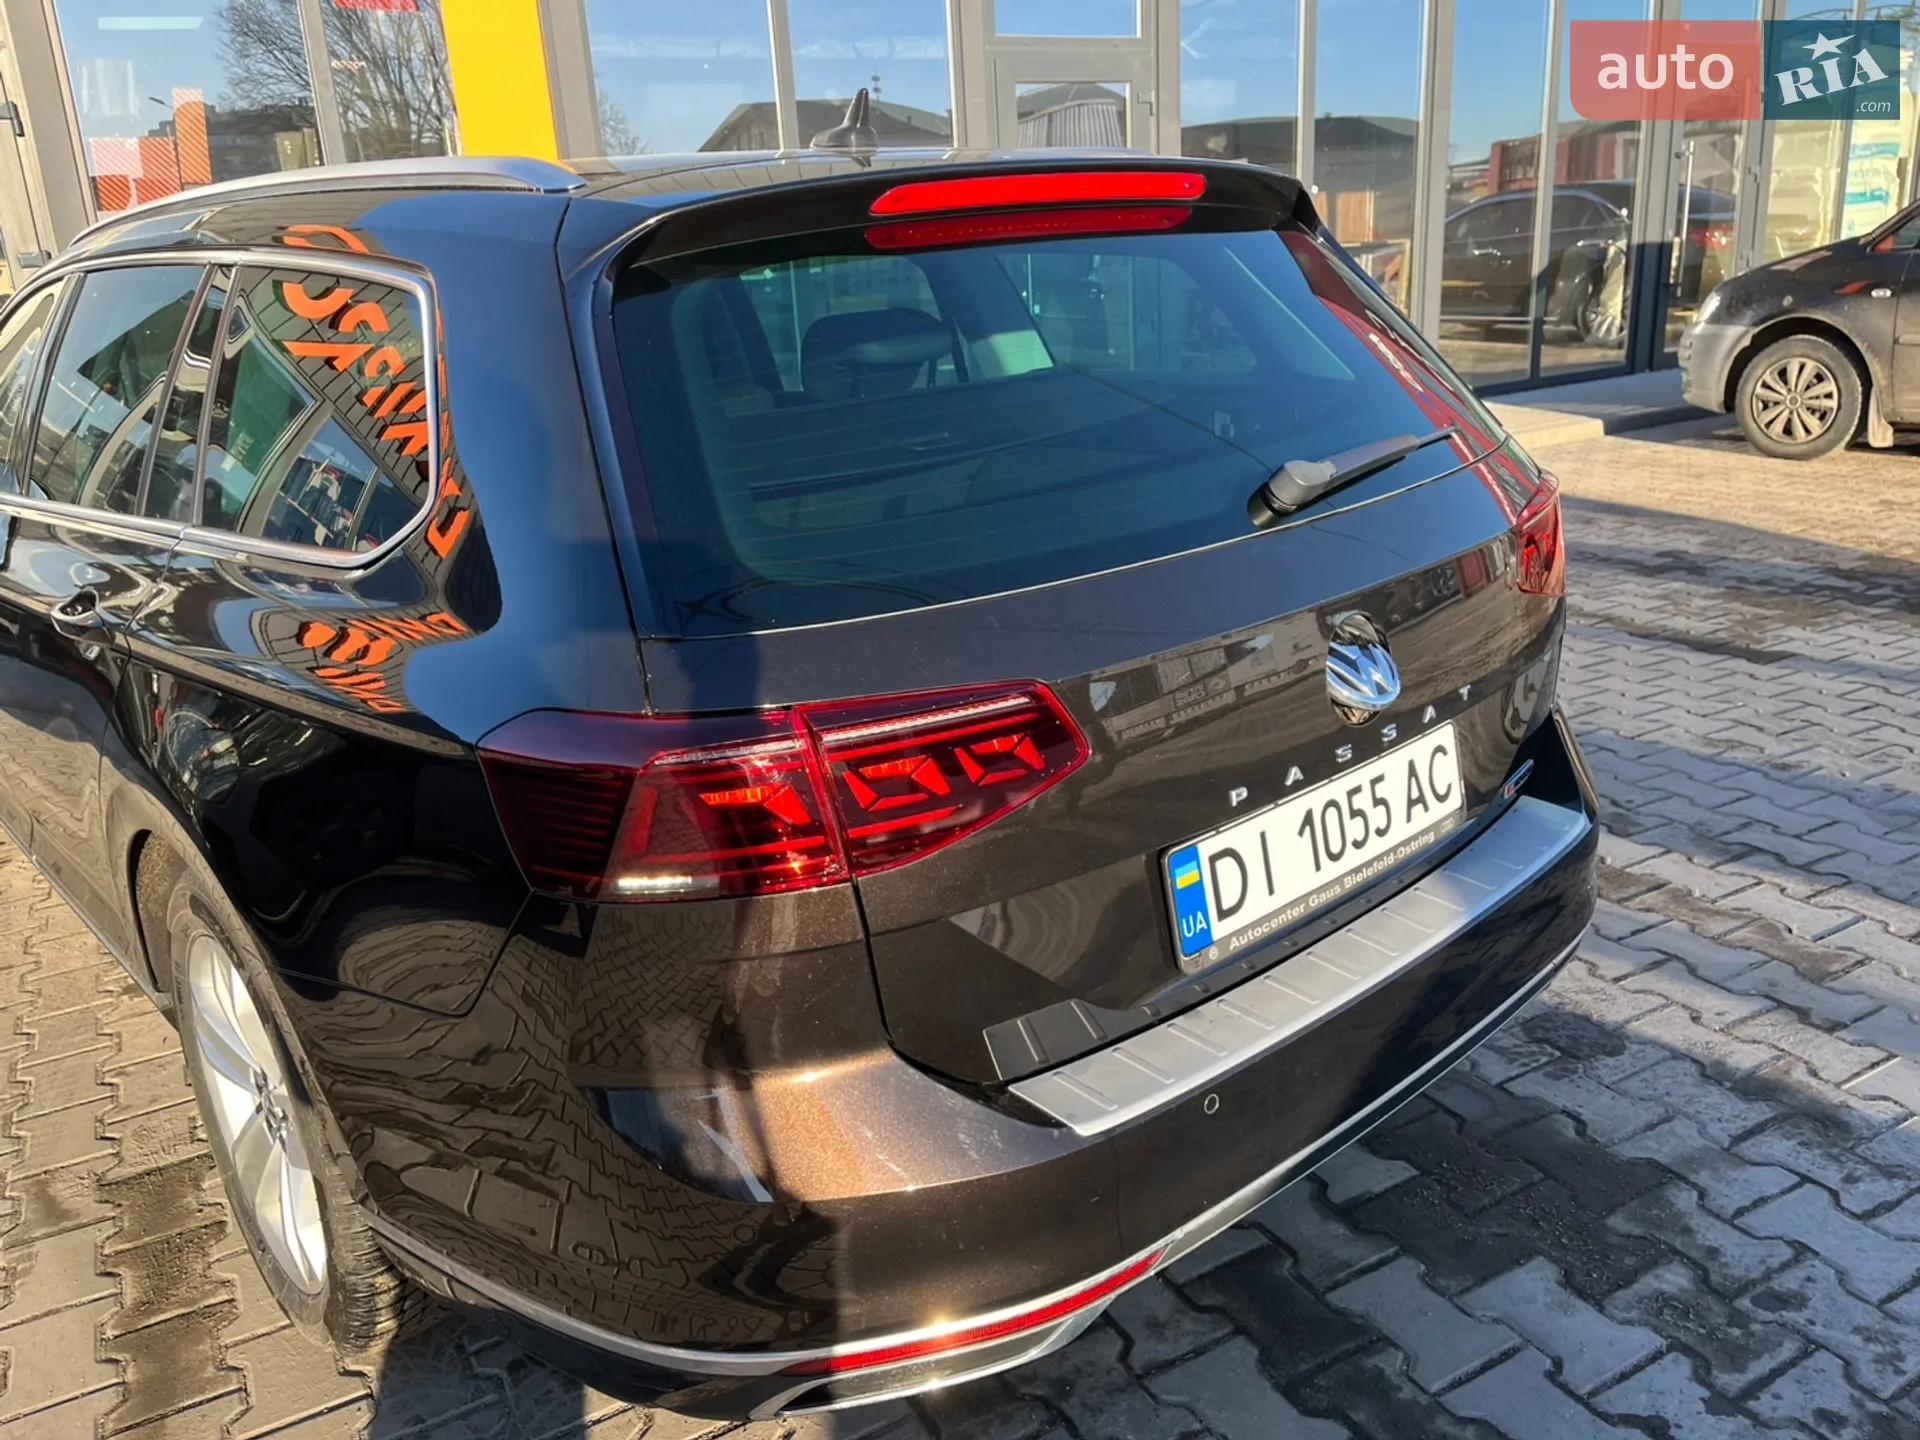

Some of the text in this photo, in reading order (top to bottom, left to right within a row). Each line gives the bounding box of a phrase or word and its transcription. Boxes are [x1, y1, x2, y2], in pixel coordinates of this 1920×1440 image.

[1229, 684, 1472, 807] PASSAT
[1208, 830, 1275, 922] DI
[1297, 773, 1393, 873] 1055
[1405, 744, 1452, 824] AC
[1228, 830, 1435, 951] Autocenter Gaus Bielefeld-Ostring
[1182, 910, 1208, 938] UA
